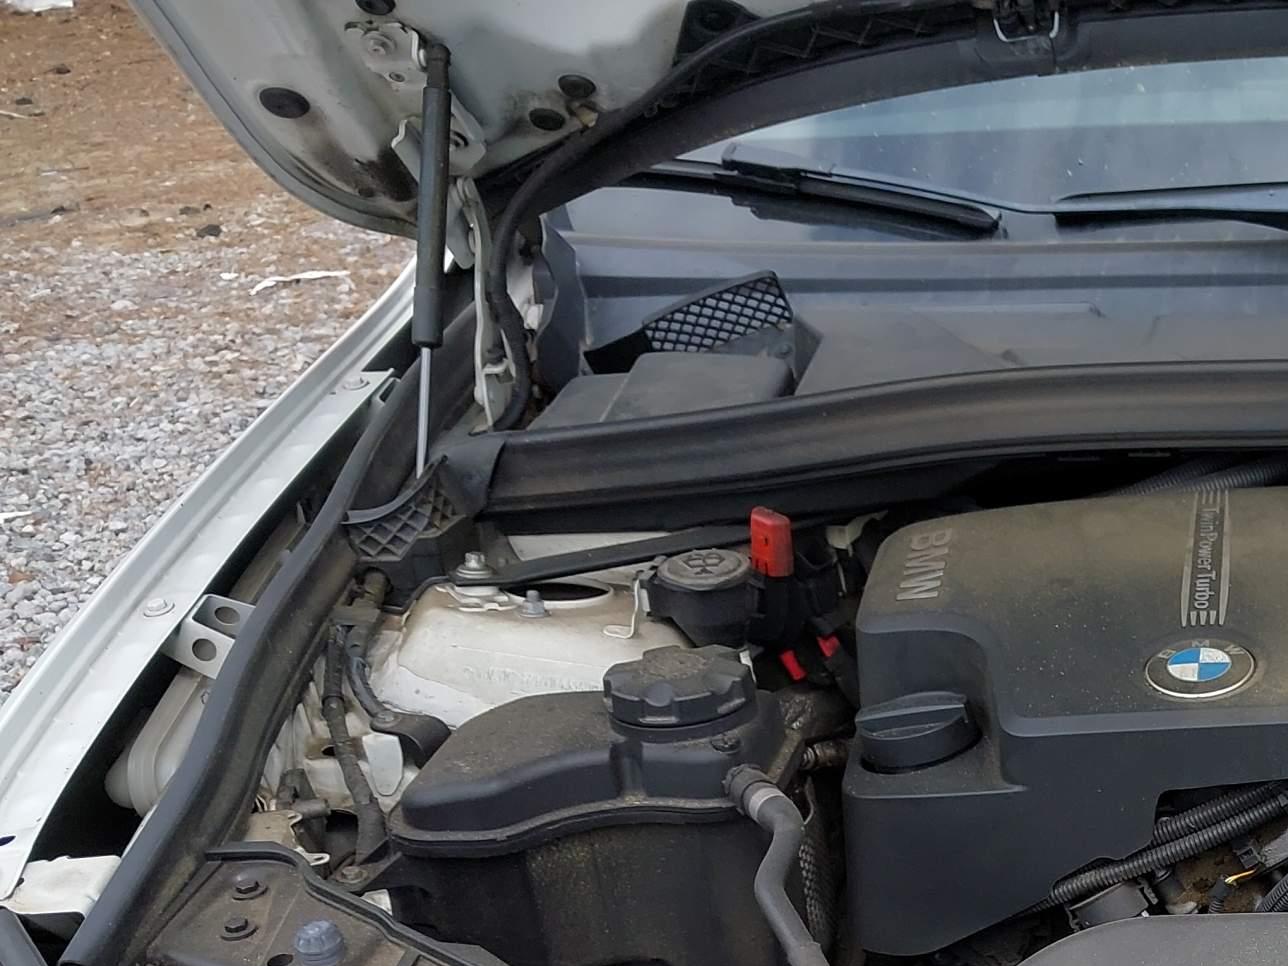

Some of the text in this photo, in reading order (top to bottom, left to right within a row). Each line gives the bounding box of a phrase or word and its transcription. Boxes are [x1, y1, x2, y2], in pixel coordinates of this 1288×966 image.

[896, 528, 952, 601] BMW
[1194, 507, 1219, 609] TwinPower Turbo
